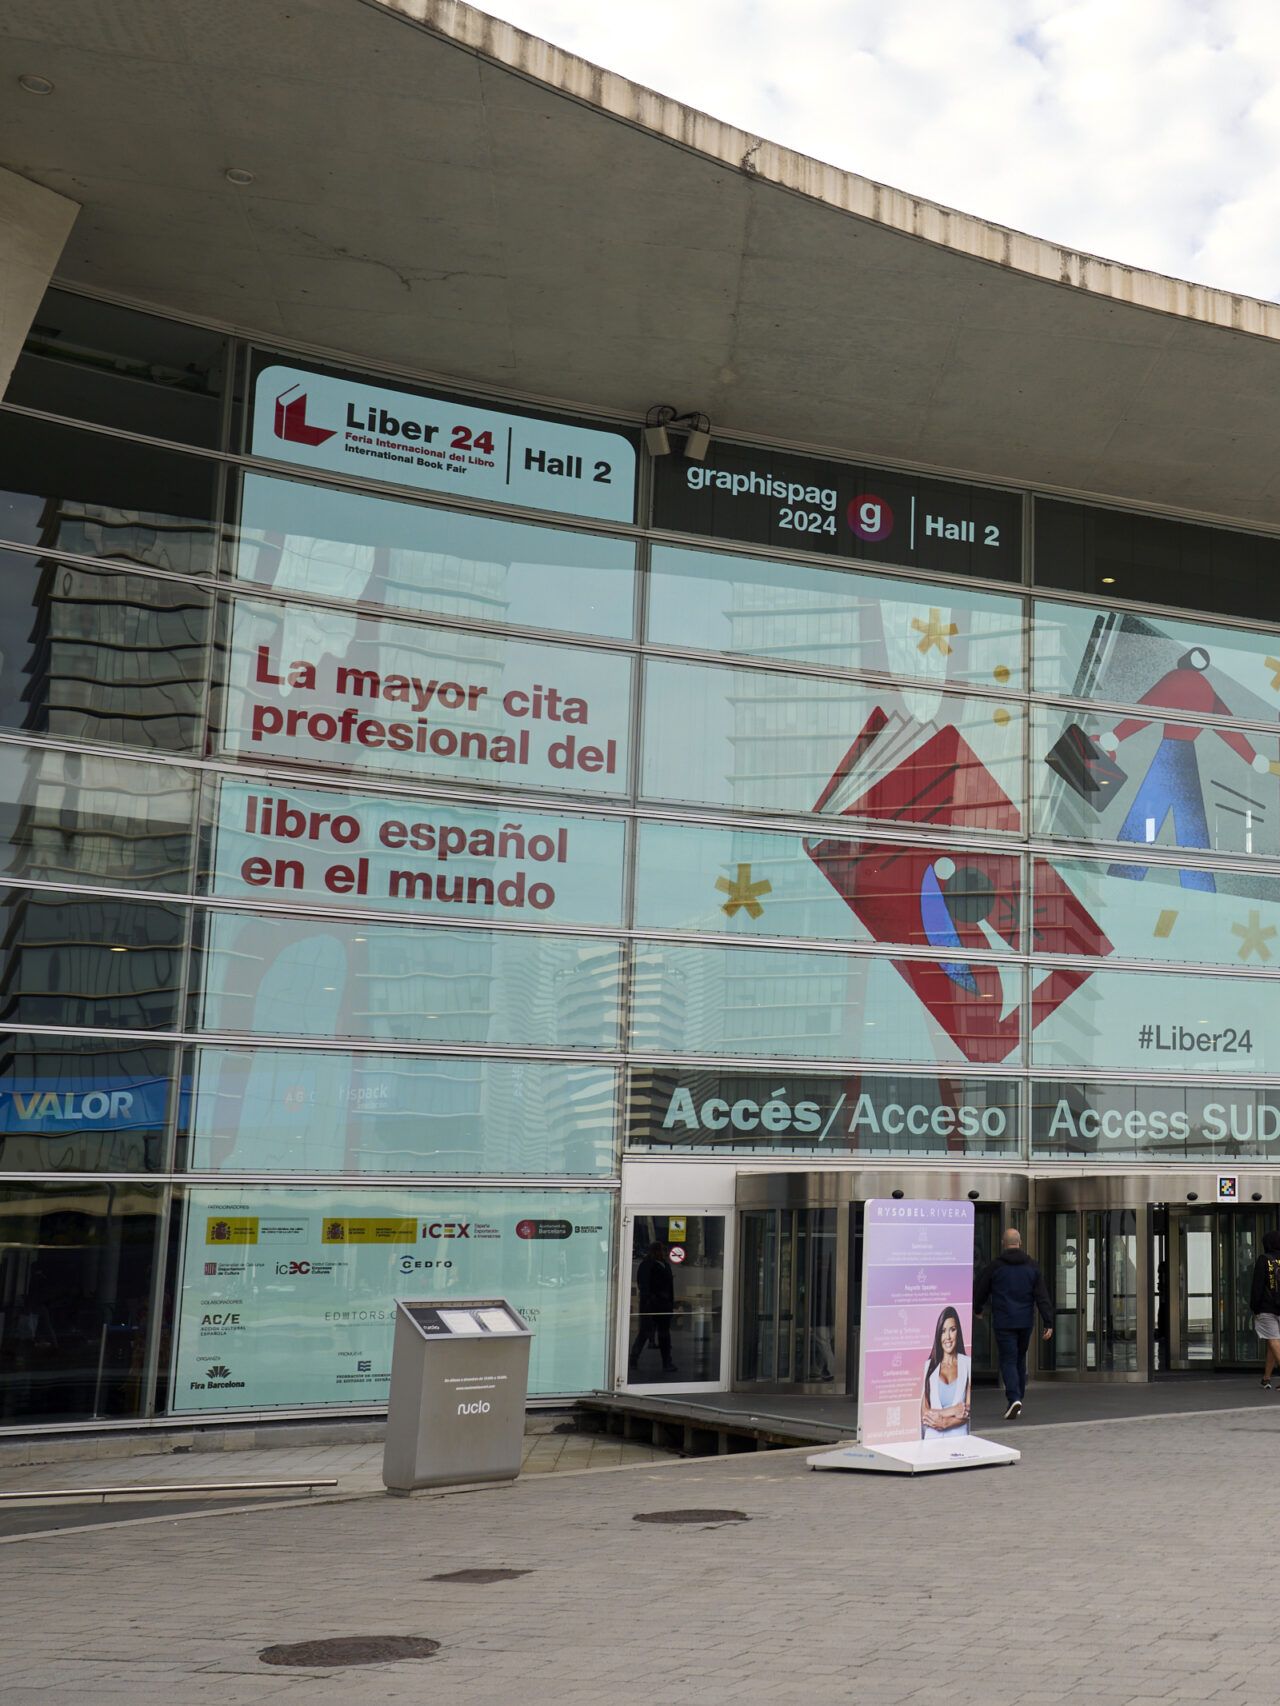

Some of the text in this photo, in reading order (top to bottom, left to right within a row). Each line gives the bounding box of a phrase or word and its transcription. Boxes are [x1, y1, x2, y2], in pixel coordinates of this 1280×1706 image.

[346, 402, 495, 455] Liber 24
[345, 432, 495, 468] Feria Internacional del Libro
[345, 443, 467, 474] International Book Fair
[525, 447, 612, 484] Hall 2
[687, 466, 837, 511] graphispag
[778, 508, 837, 535] 2024
[860, 502, 881, 533] g
[925, 515, 1000, 546] Hall 2
[255, 645, 589, 725] La mayor cita
[252, 704, 617, 774] profesional del
[245, 795, 568, 863] libro español
[240, 857, 555, 910] en el mundo
[1138, 1025, 1253, 1054] #Liber24
[13, 1091, 134, 1120] VALOR
[1048, 1099, 1190, 1140] Access
[190, 1380, 245, 1390] Fira Barcelona
